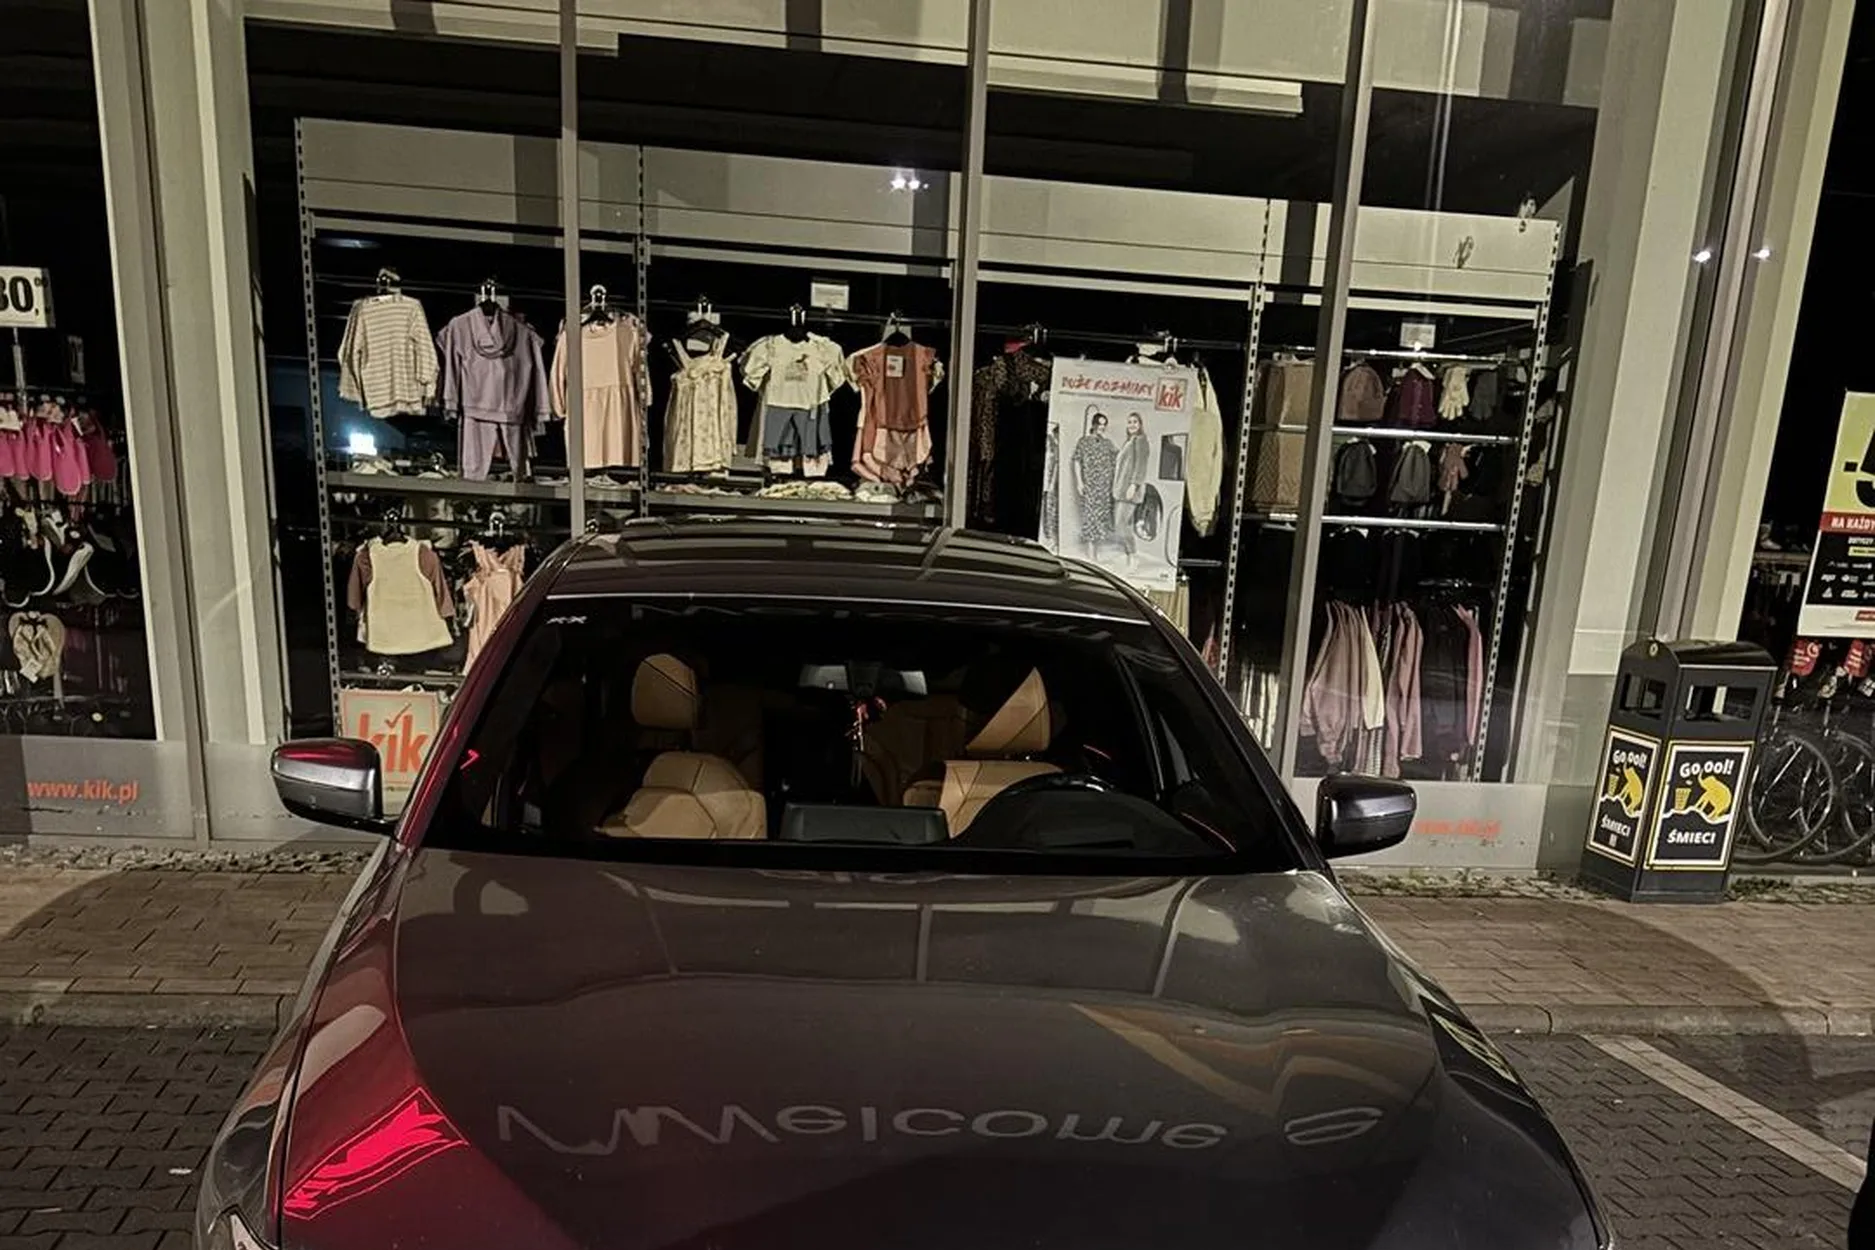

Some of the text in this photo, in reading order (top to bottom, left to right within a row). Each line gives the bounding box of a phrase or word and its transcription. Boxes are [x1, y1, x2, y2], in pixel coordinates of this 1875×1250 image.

[1159, 384, 1183, 408] kik
[27, 780, 138, 804] www.kik.pl
[1667, 829, 1716, 844] ŚMIECI
